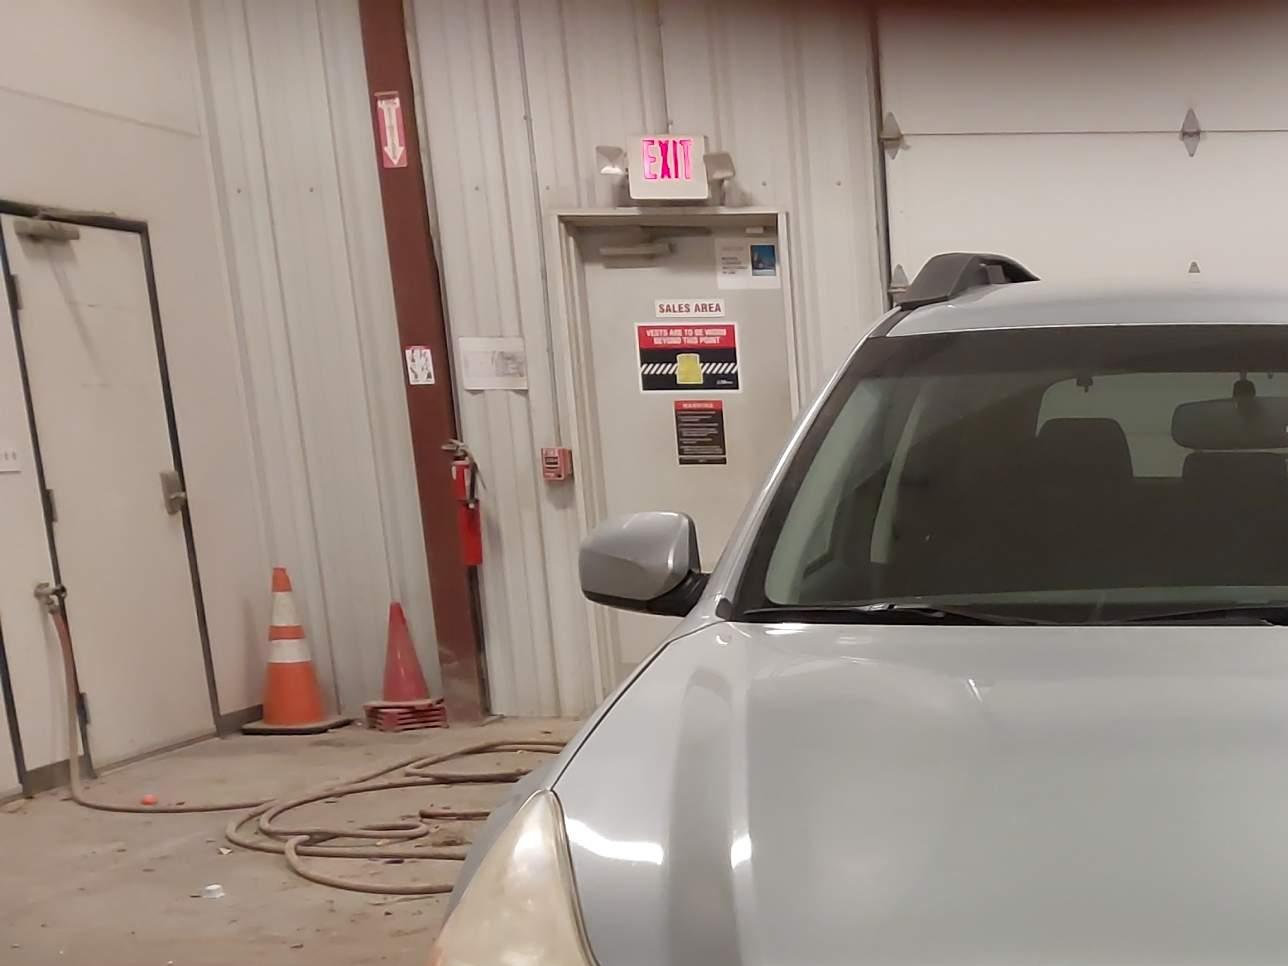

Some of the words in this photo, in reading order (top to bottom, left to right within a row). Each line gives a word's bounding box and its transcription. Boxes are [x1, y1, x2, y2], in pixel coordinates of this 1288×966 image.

[642, 139, 692, 180] EXIT
[658, 303, 691, 314] SALES
[694, 303, 721, 313] AREA
